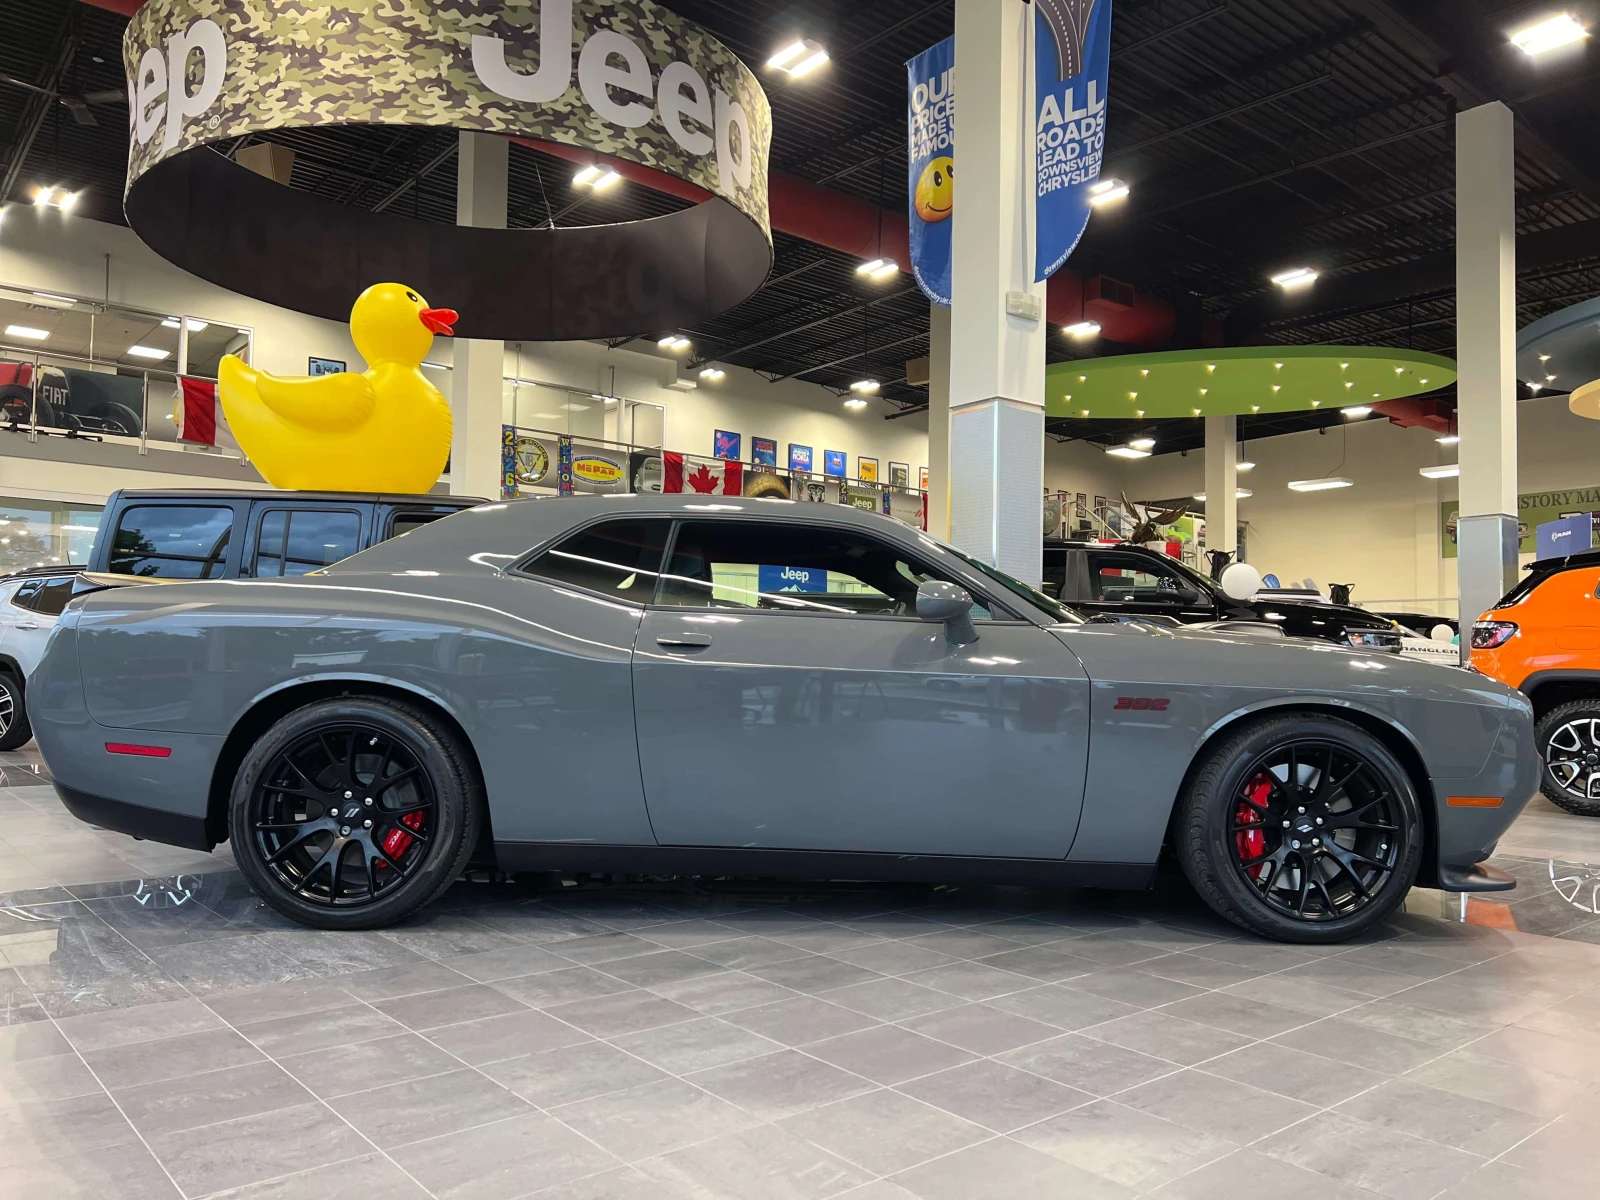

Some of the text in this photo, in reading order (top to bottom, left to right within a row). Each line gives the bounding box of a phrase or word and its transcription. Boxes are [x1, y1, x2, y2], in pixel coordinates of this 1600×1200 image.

[128, 18, 227, 153] ep
[471, 0, 752, 196] Jeep
[911, 97, 954, 134] PRICE
[1037, 80, 1105, 134] ALL
[911, 118, 947, 149] MADE
[911, 131, 954, 164] FAMO
[1037, 109, 1104, 154] ROADS
[1038, 131, 1103, 171] LEAD TO
[1038, 148, 1103, 184] DOWNSVIEW
[1038, 161, 1102, 197] CHRYSLER
[42, 384, 69, 406] FIAT
[852, 498, 872, 509] Jeep
[1518, 491, 1573, 510] ISTORY
[1557, 530, 1572, 538] RAM
[781, 566, 809, 583] Jeep
[1402, 646, 1459, 655] RANGLER
